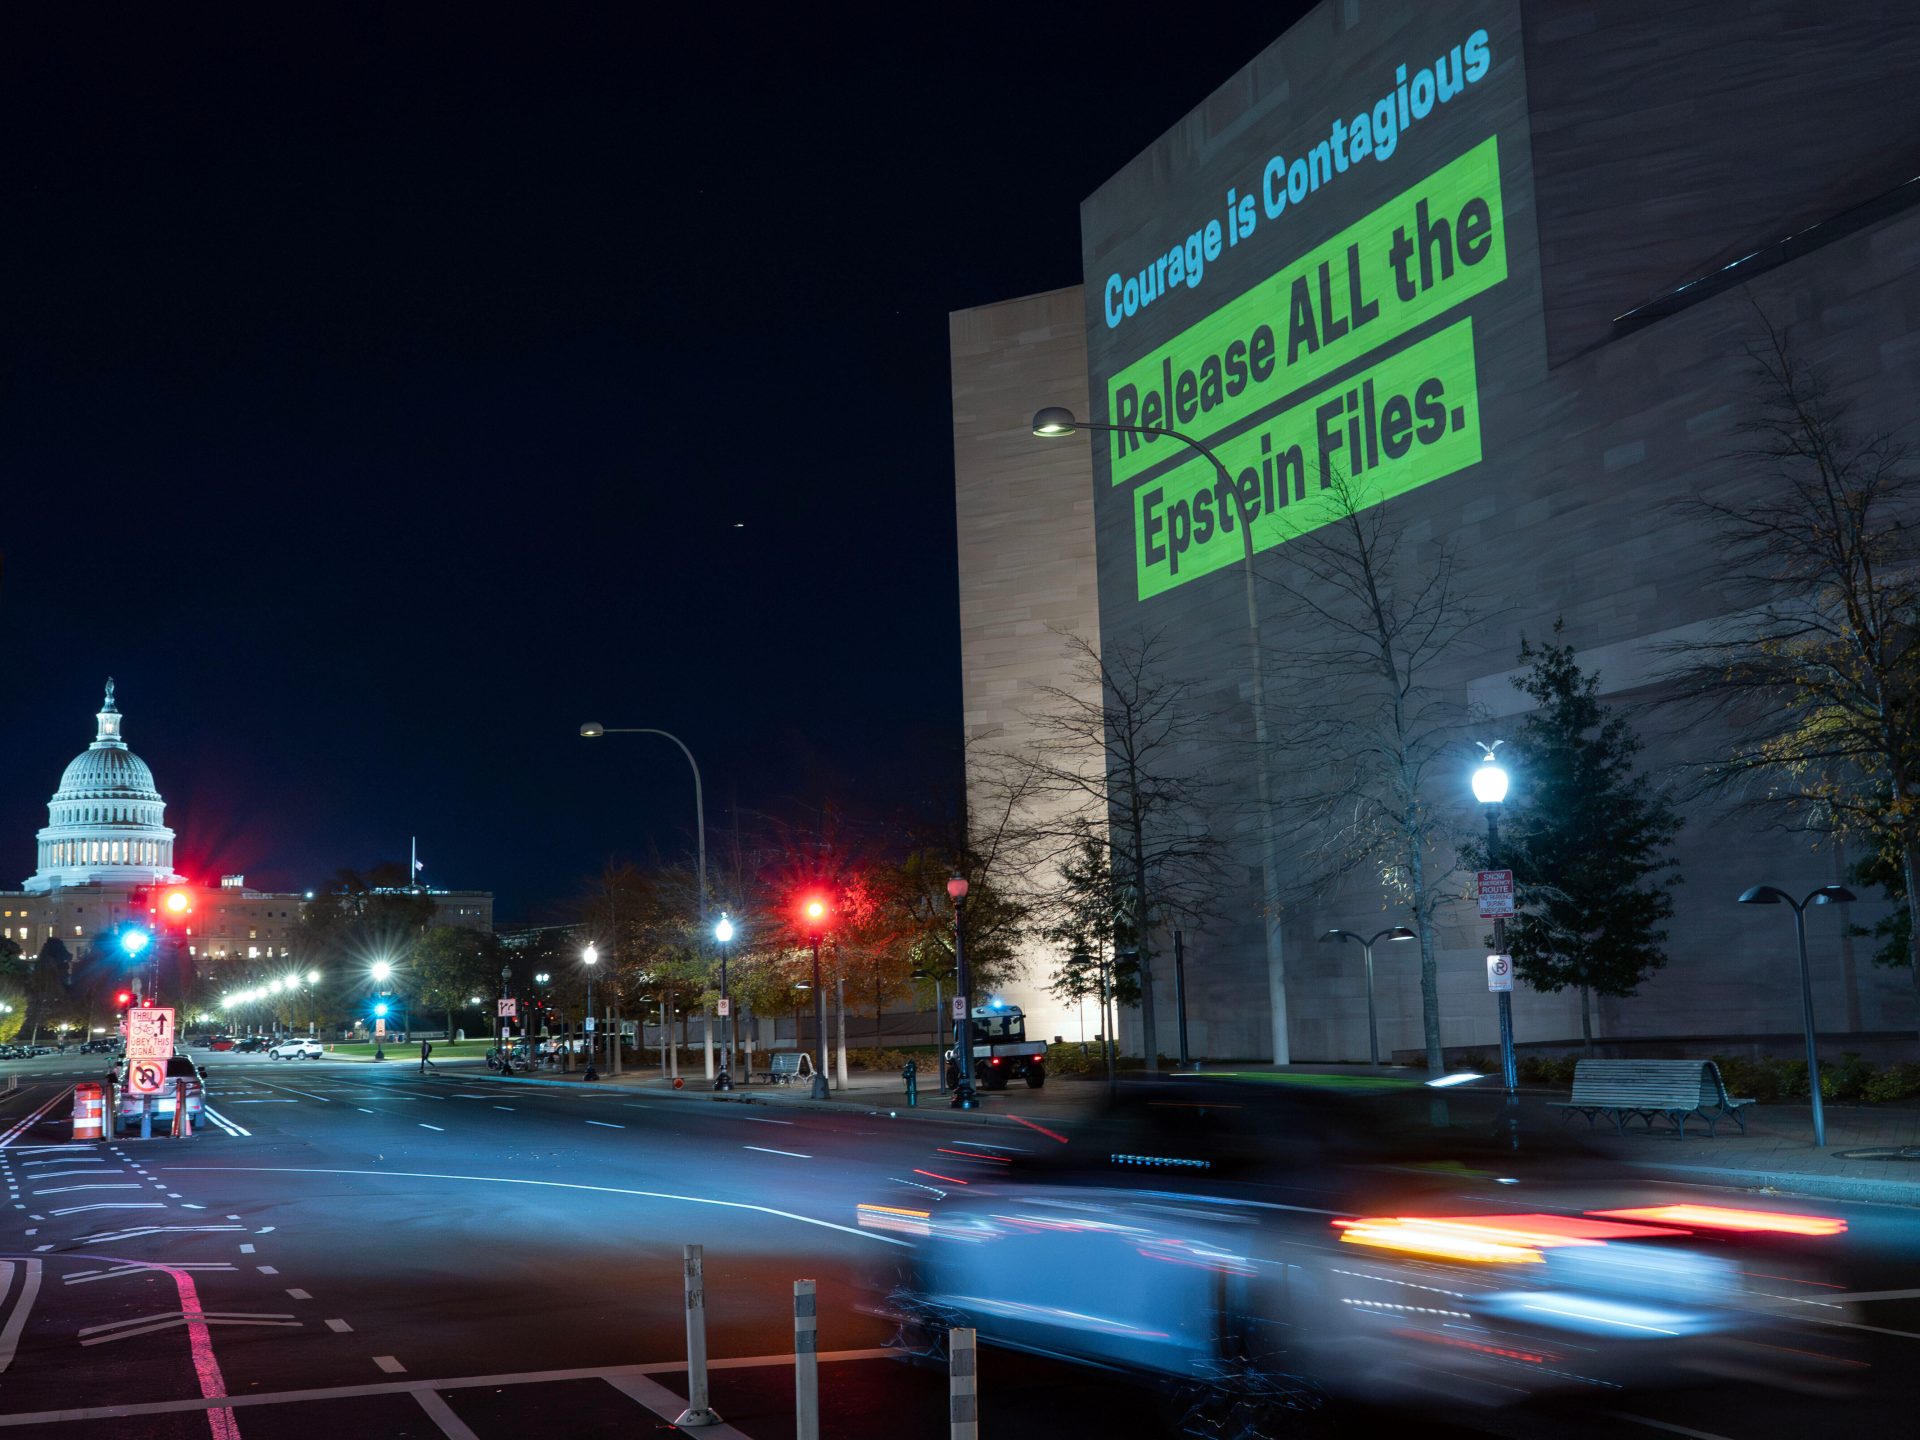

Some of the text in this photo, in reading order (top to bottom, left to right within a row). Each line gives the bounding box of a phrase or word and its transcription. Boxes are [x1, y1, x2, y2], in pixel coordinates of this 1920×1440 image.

[1104, 28, 1491, 329] Courage is Contagious
[1114, 197, 1493, 460] Release ALL the
[1142, 377, 1466, 577] Epstein Files.
[130, 1047, 157, 1056] SIGNAL
[133, 1011, 153, 1019] THRU
[153, 1037, 170, 1046] THIS
